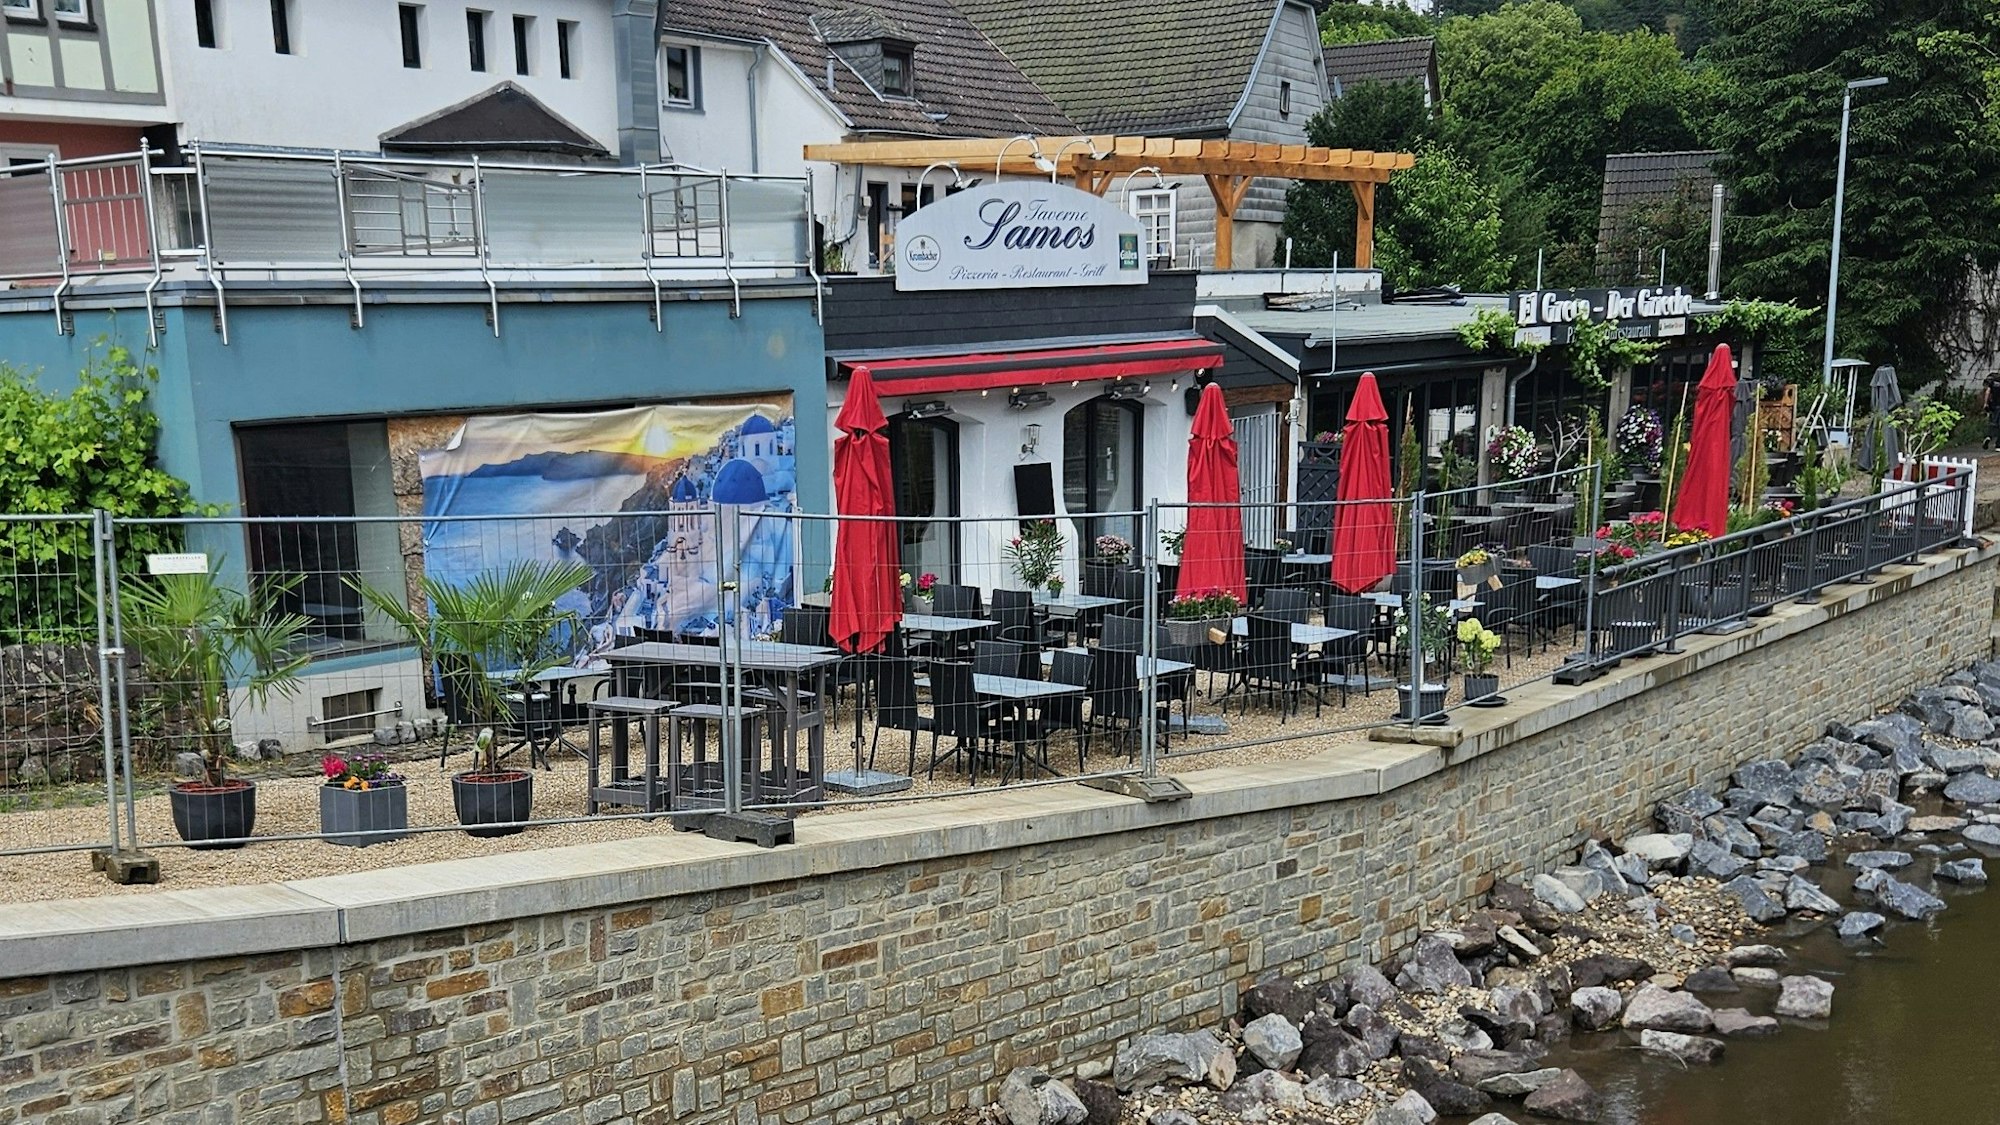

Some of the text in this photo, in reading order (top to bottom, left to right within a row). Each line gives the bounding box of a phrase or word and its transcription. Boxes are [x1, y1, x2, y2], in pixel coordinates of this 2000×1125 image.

[964, 198, 1095, 250] Samos
[1025, 199, 1089, 222] Taverne
[949, 265, 998, 281] Pizzeria
[1009, 264, 1070, 280] Restaurant
[1079, 263, 1106, 278] Grill
[1518, 292, 1538, 325] El
[1606, 290, 1636, 320] Der
[1637, 286, 1693, 318] Grieche
